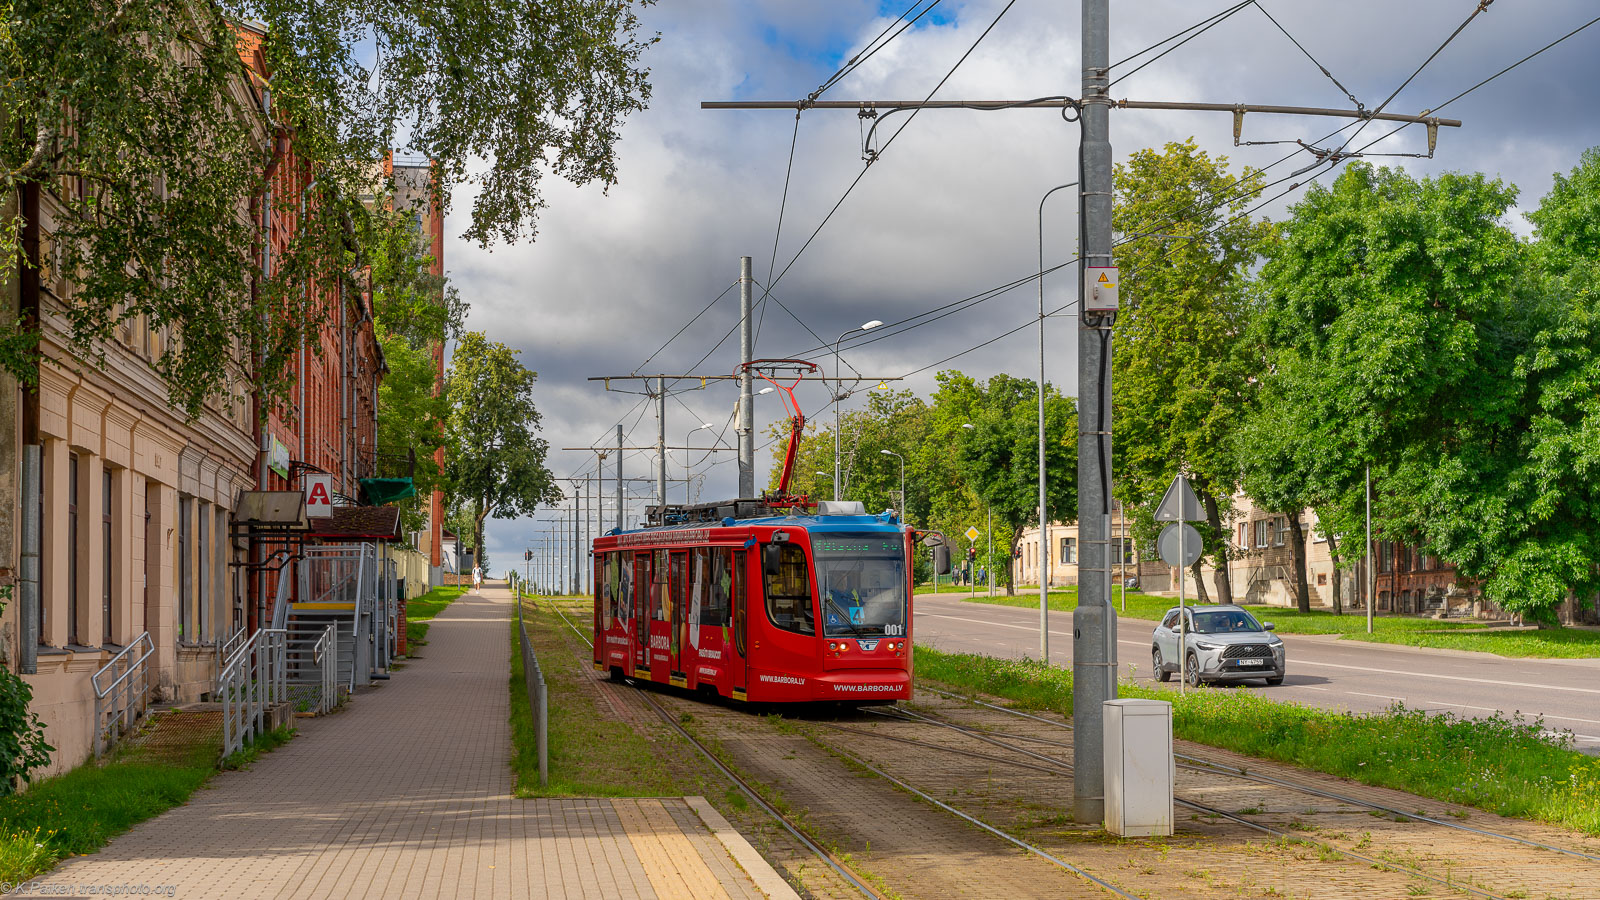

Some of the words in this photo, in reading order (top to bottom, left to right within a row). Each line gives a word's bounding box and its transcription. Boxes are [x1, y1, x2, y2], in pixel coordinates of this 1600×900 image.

[307, 483, 331, 505] A
[852, 608, 863, 624] 4
[884, 624, 903, 636] 001
[650, 634, 671, 651] BARBORA
[759, 674, 806, 686] WWW.BARBORA.LV
[833, 684, 904, 692] WWW.BARBORA.LV
